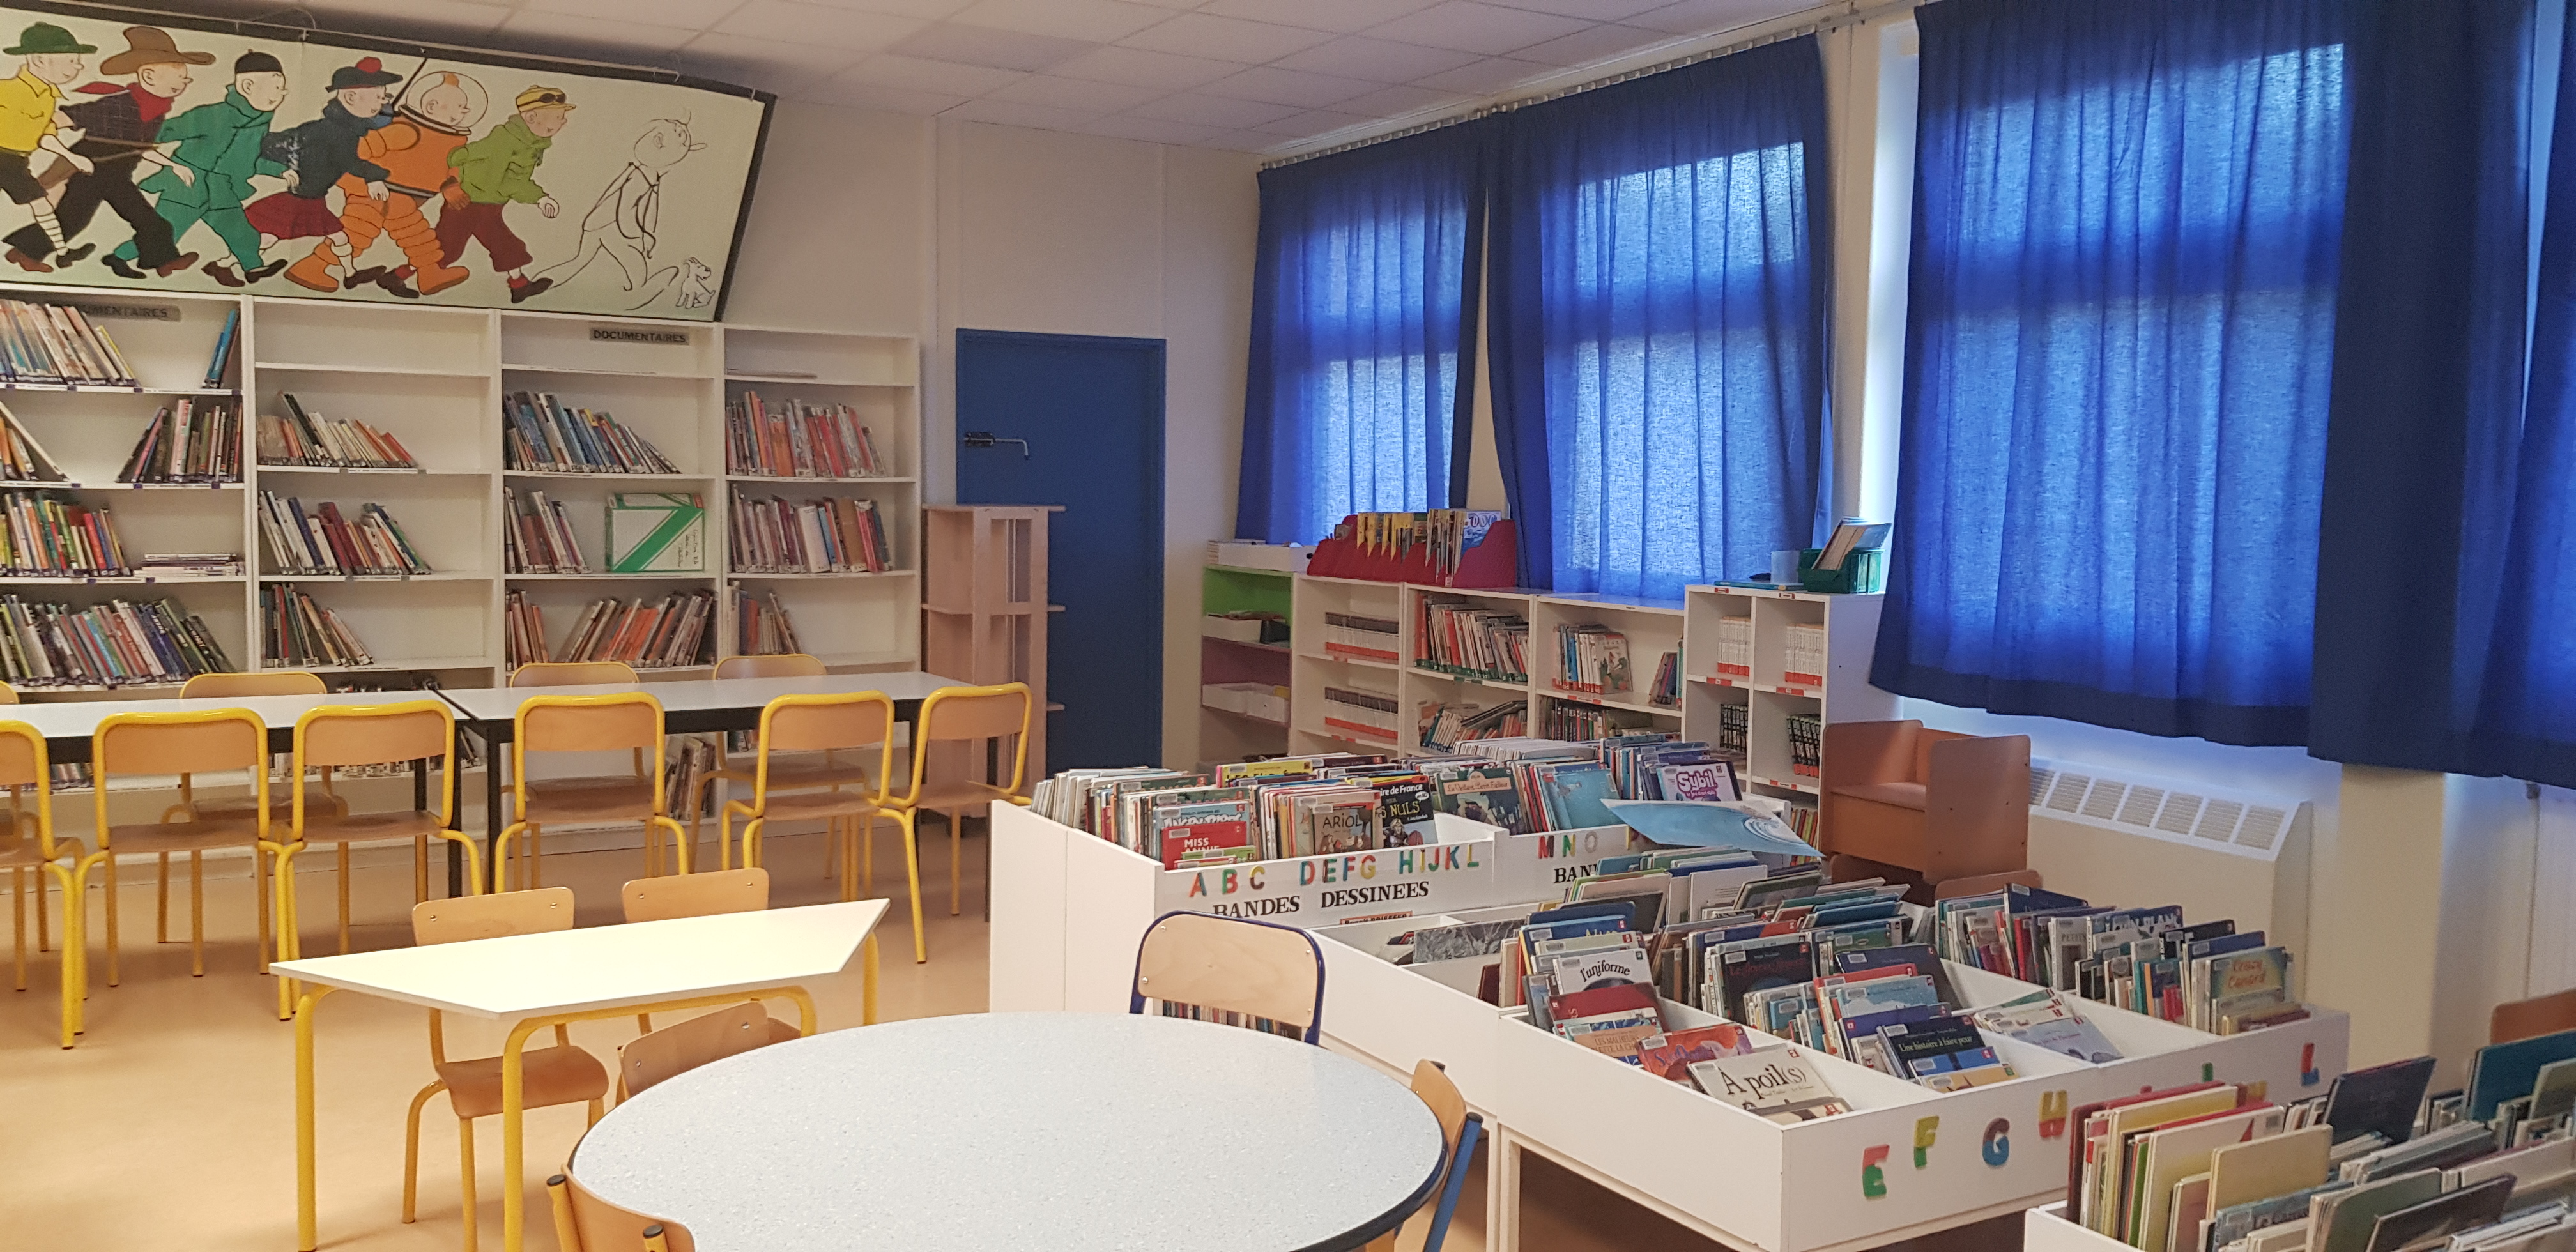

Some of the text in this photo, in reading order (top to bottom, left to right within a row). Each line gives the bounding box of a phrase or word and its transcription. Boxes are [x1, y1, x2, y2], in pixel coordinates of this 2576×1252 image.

[594, 329, 686, 343] DOCUMENTAIRES
[1390, 785, 1399, 795] de
[1399, 783, 1423, 794] France
[1677, 768, 1717, 792] Sybil
[1390, 801, 1420, 817] NULS
[1184, 837, 1209, 848] MISS
[1538, 835, 1554, 859] M
[1562, 834, 1576, 857] N
[1188, 871, 1207, 898] A
[1222, 869, 1238, 895] B
[1249, 866, 1265, 890] C
[1321, 881, 1430, 909] DESSINEES
[1579, 959, 1630, 982] l'uniforme
[1898, 1042, 1913, 1052] Une
[1913, 1039, 1938, 1051] histoire
[1943, 1036, 1958, 1046] faire
[1958, 1036, 1972, 1046] peur
[1744, 1064, 1807, 1100] poil(s)
[1862, 1143, 1890, 1198] E
[1913, 1115, 1940, 1169] F
[1982, 1117, 2010, 1168] G
